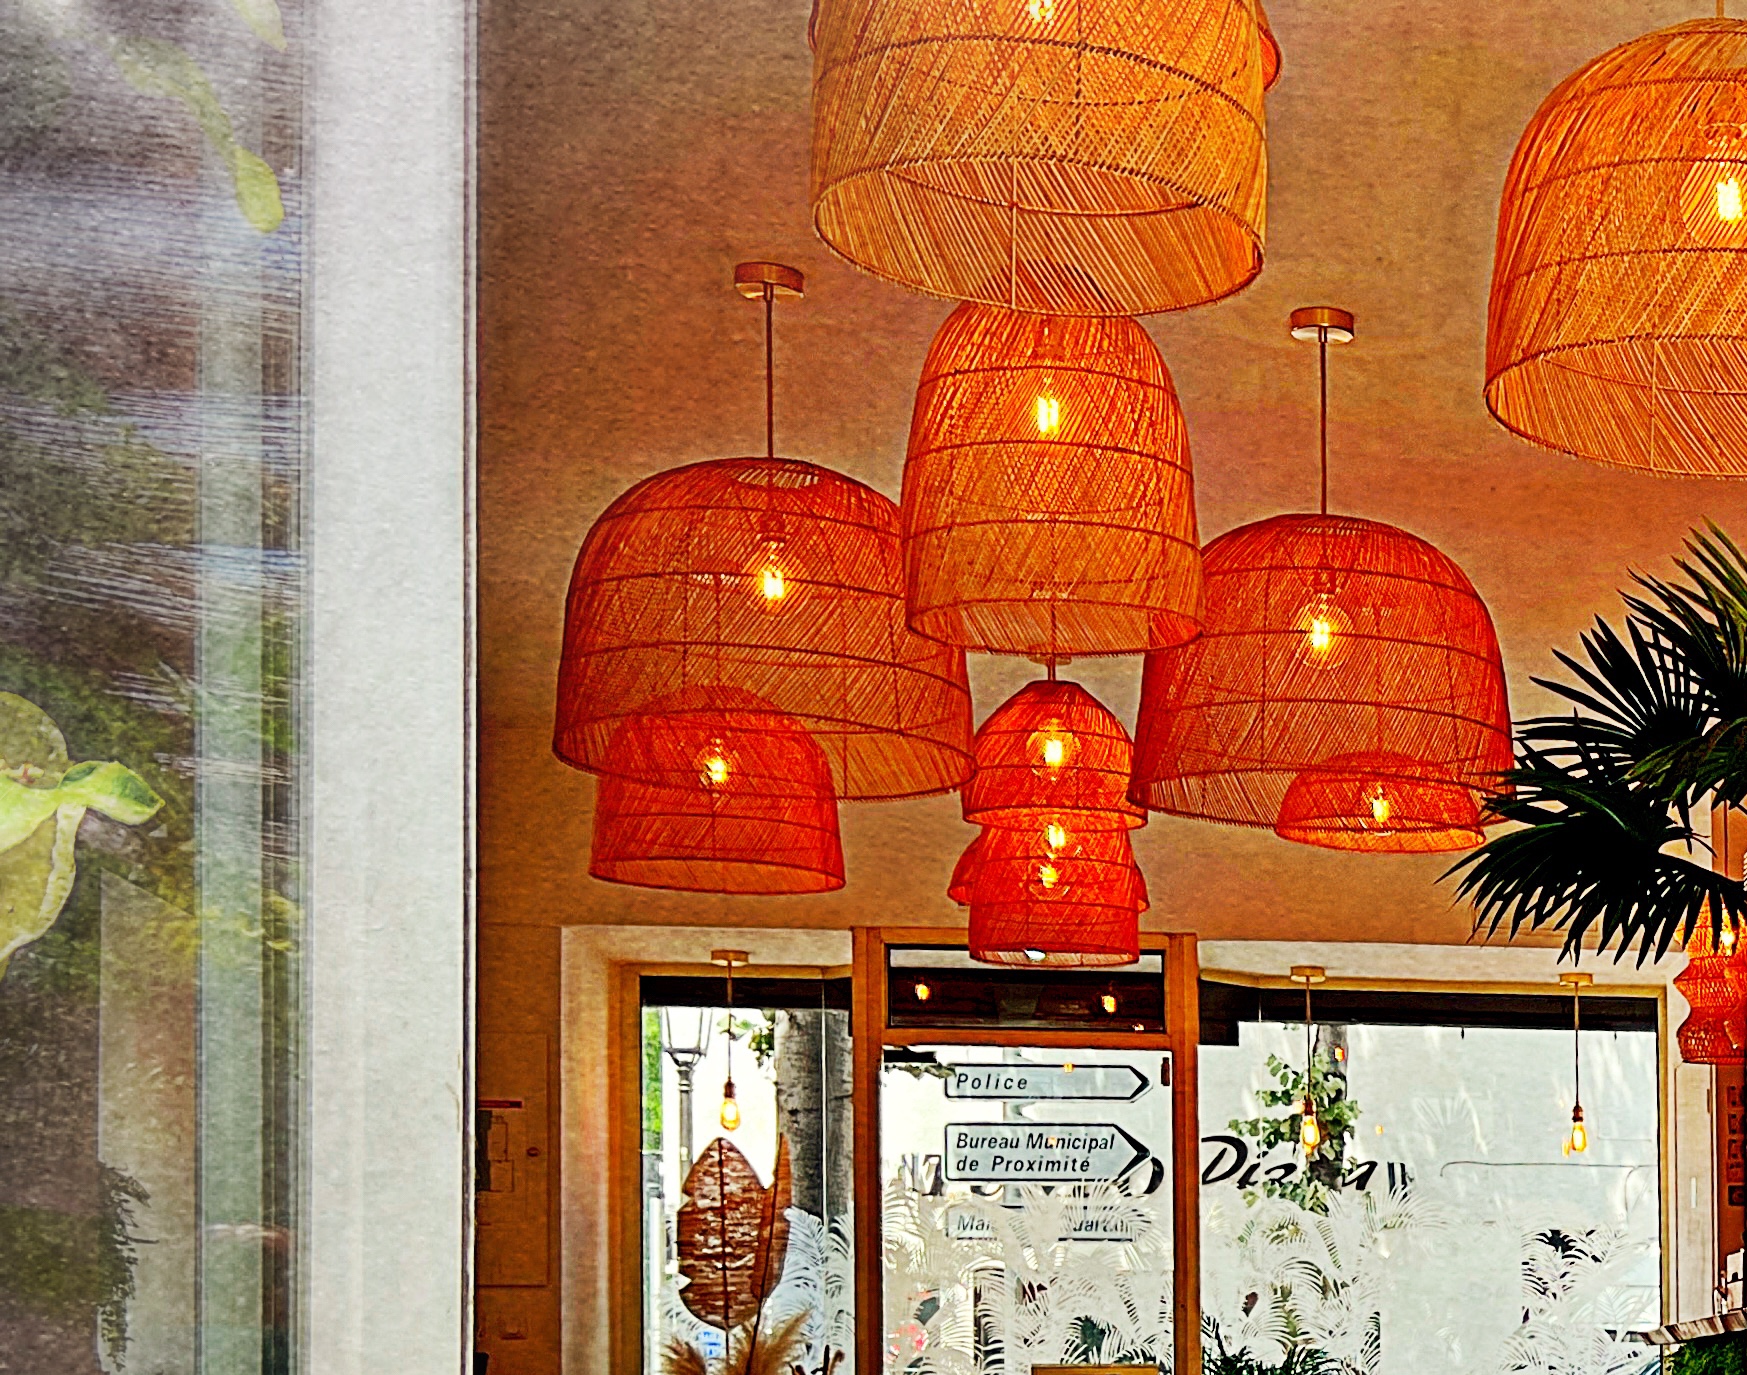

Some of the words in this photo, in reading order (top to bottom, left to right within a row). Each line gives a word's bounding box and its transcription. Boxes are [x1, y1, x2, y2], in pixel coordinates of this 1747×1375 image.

[956, 1073, 1028, 1090] Police
[956, 1133, 1020, 1149] Bureau
[1026, 1133, 1115, 1153] Municipal
[956, 1155, 979, 1172] de
[991, 1155, 1090, 1173] Proximité
